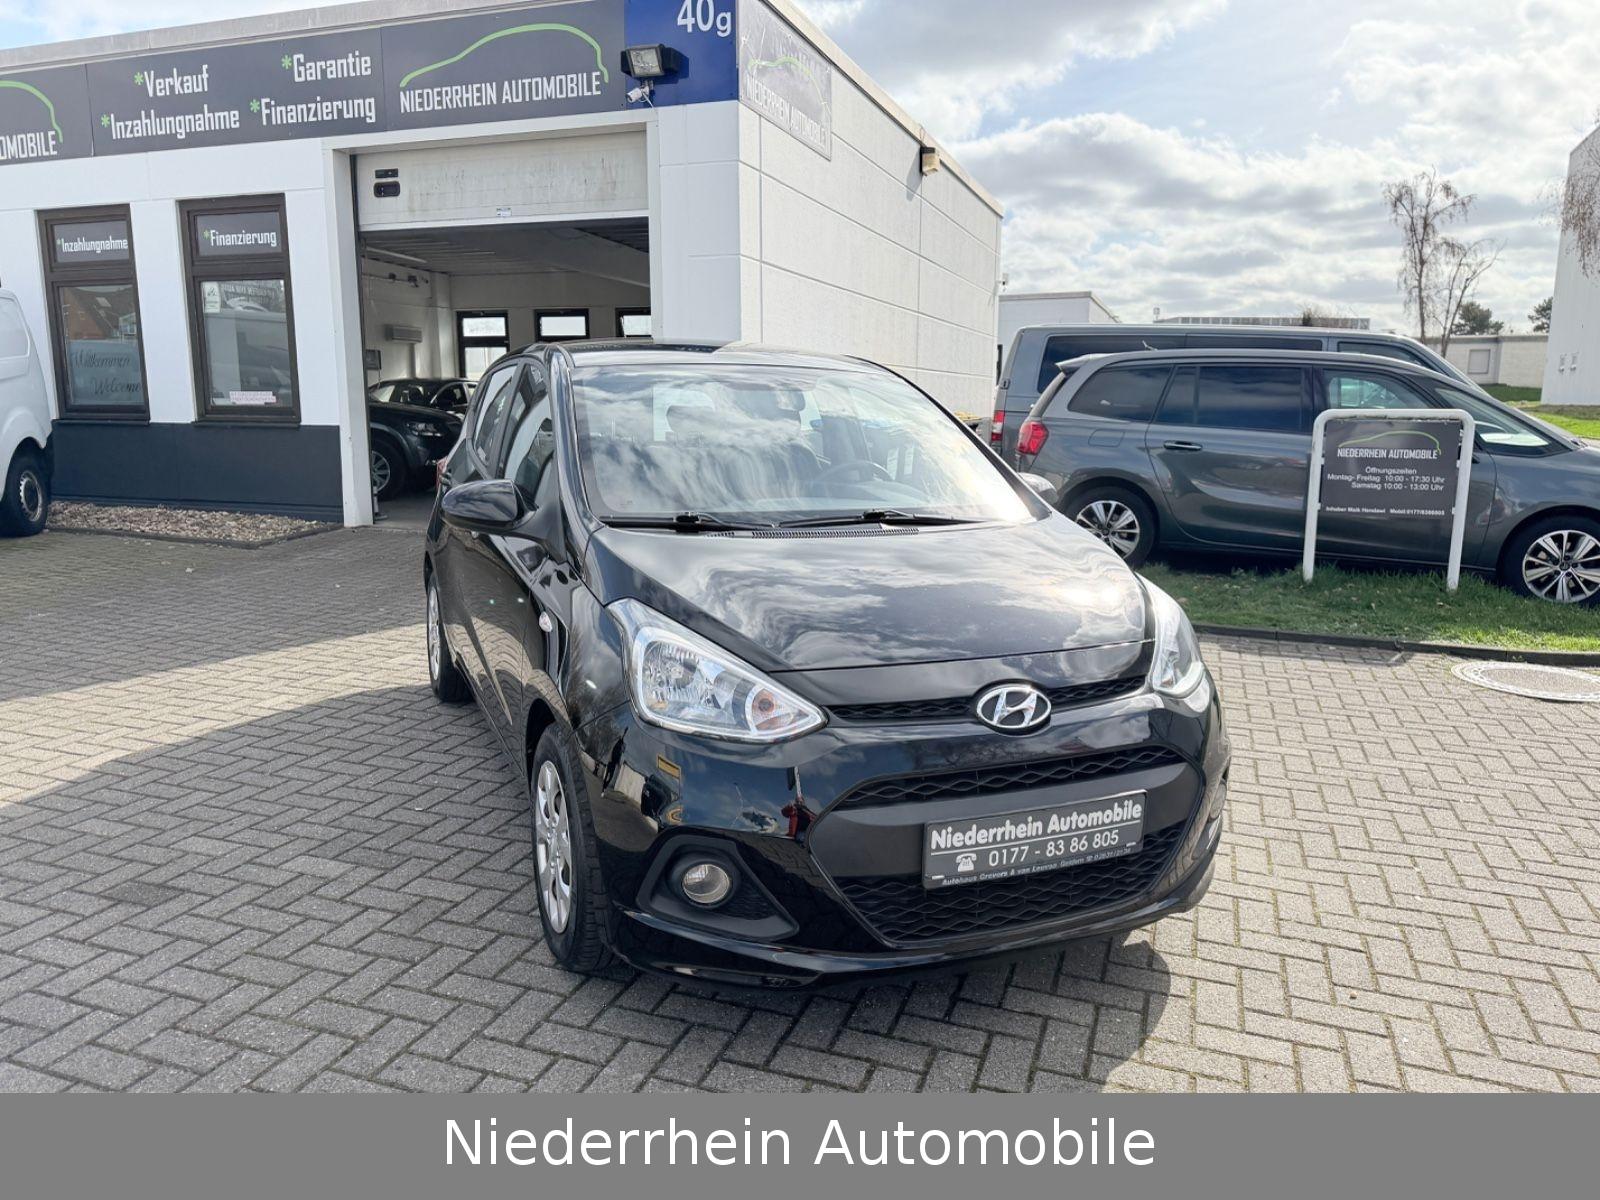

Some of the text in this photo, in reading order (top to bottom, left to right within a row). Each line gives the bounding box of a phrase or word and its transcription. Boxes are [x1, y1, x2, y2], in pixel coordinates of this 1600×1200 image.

[677, 0, 732, 38] 40g
[399, 72, 602, 114] NIEDERRHEIN AUTOMOBILE
[1337, 448, 1438, 459] NIEDERRHEIN AUTOMOBILE
[1351, 482, 1381, 491] Samstag
[1356, 474, 1380, 483] Freitag
[930, 800, 1142, 850] Niederrhein Automobile
[988, 845, 1030, 867] 0177
[1046, 839, 1065, 857] 83
[1069, 834, 1088, 853] 86
[1092, 829, 1119, 849] 805
